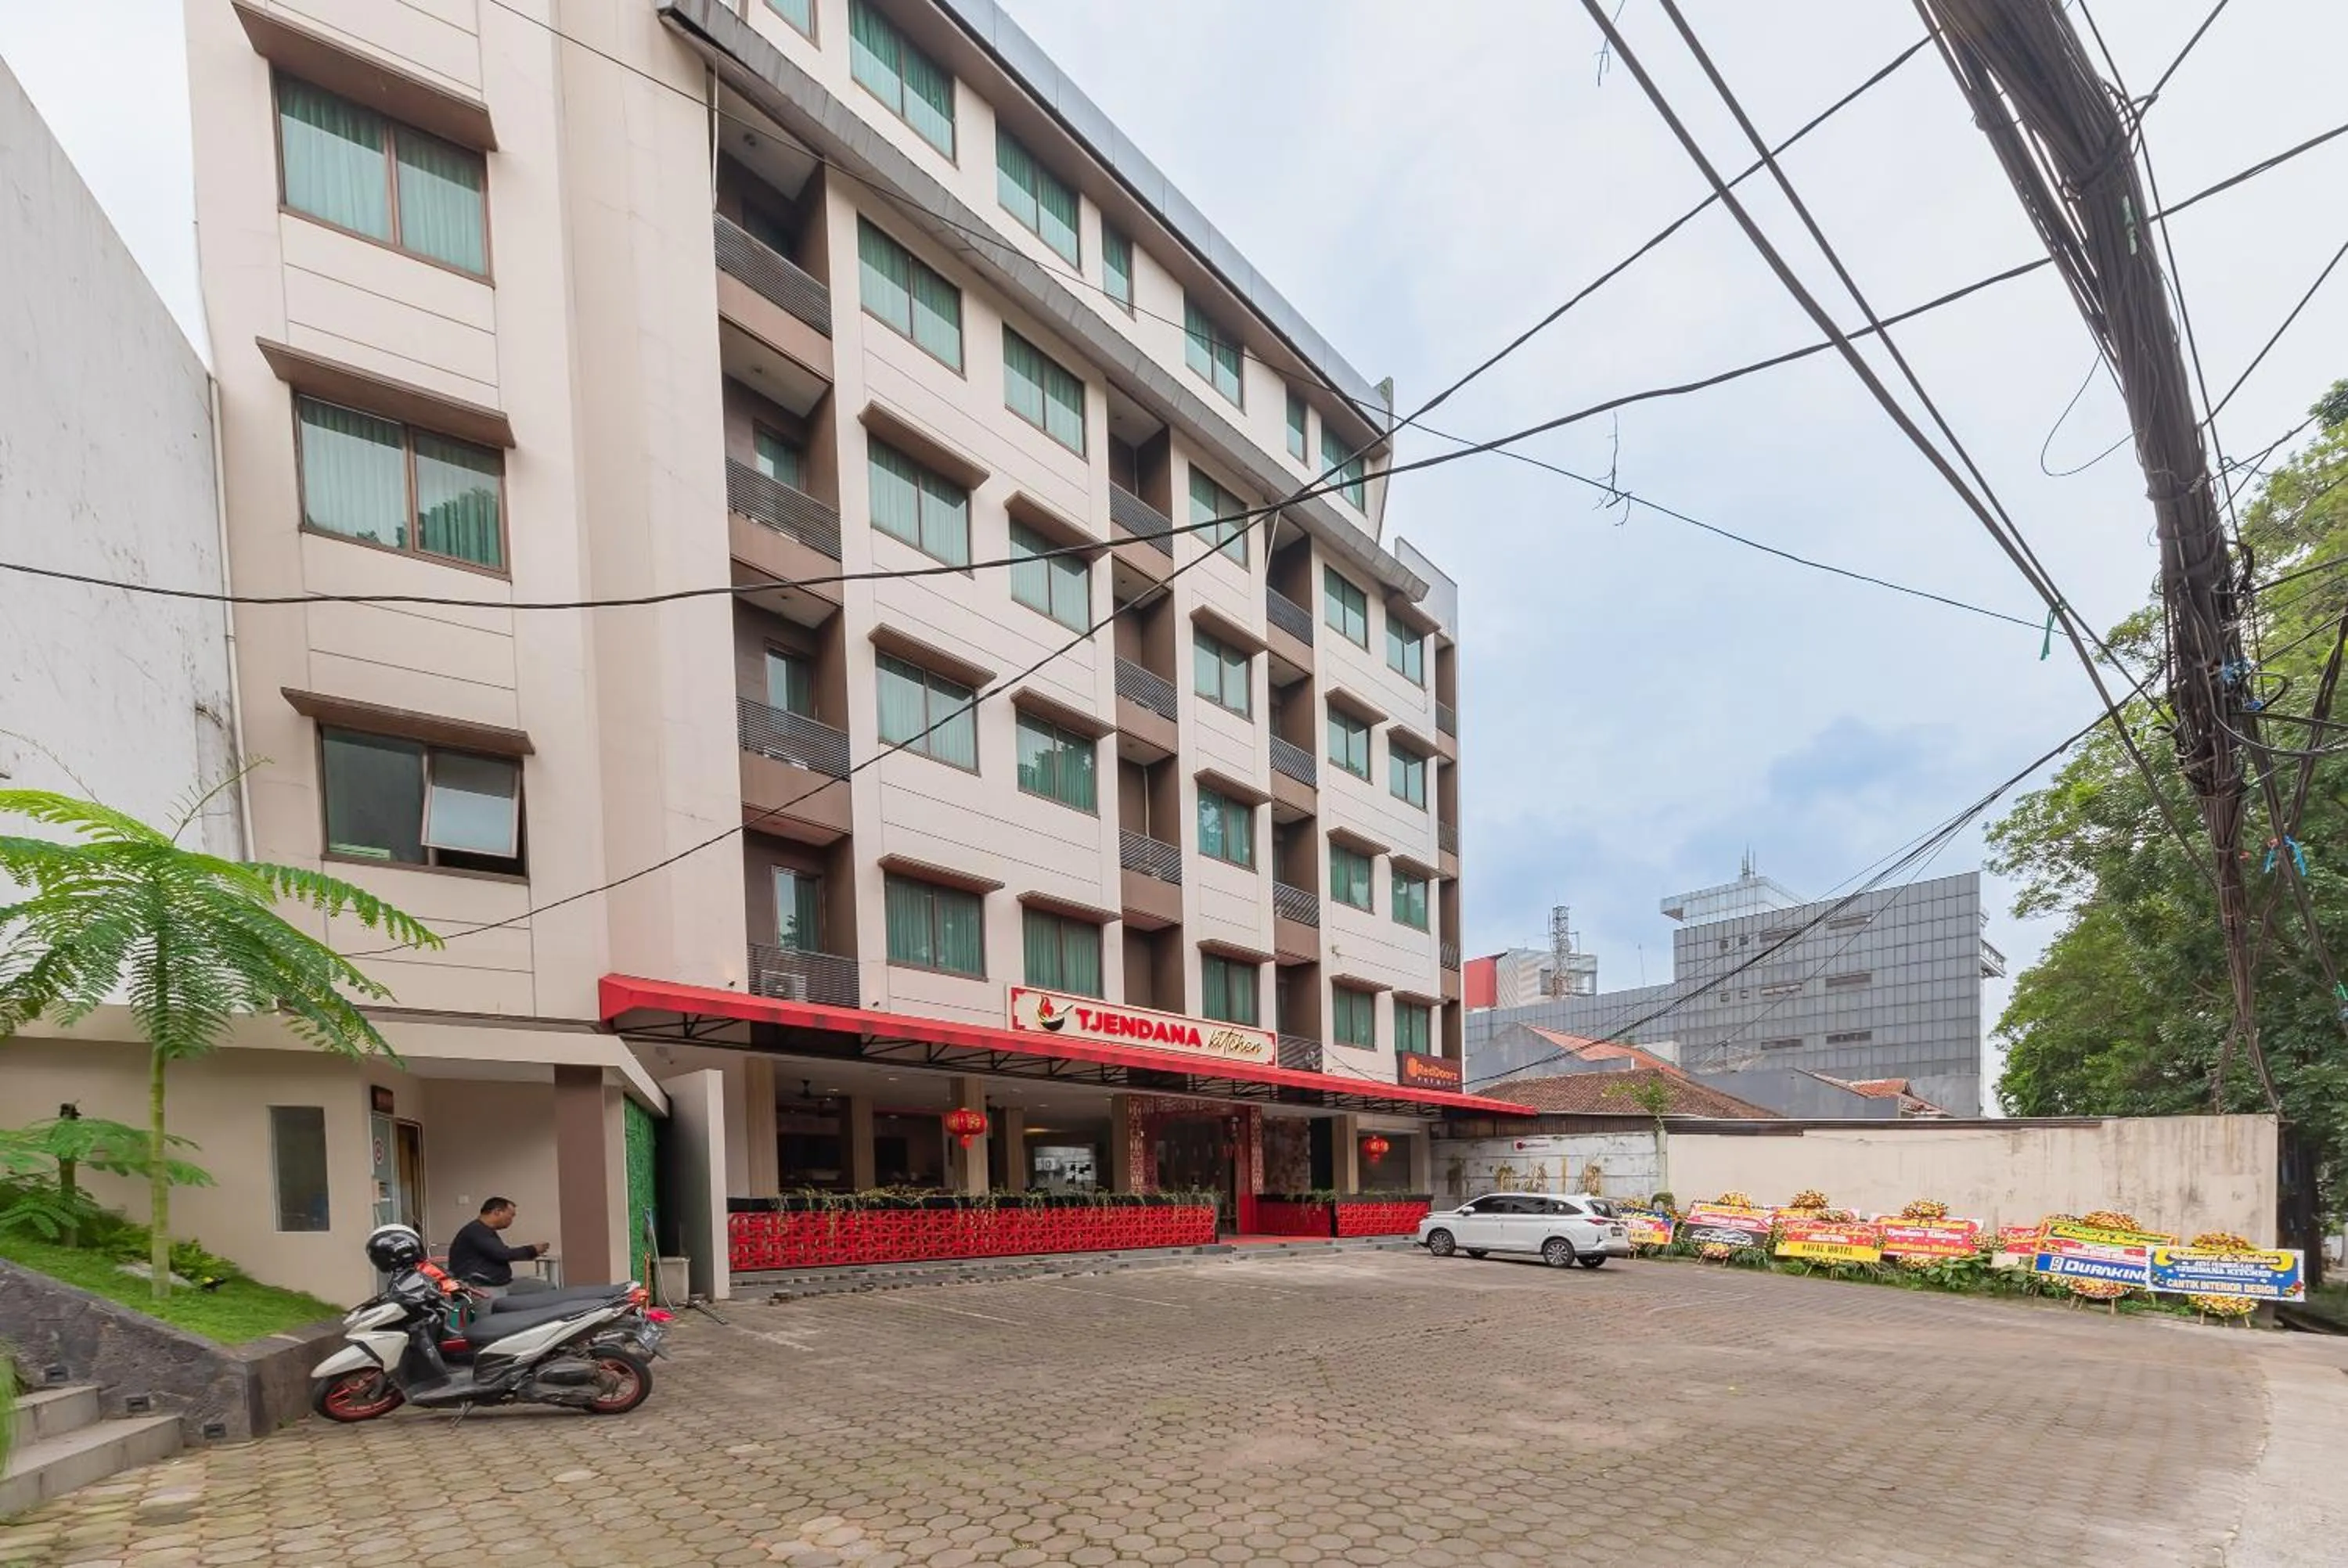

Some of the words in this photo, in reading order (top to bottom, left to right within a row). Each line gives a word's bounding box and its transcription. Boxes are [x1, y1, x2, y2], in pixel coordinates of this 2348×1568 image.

[1075, 1007, 1202, 1048] TJENDANA
[1208, 1027, 1263, 1056] kitchen
[2227, 1268, 2274, 1277] KITCHEN
[2166, 1278, 2199, 1289] CANTIK
[2200, 1281, 2242, 1293] INTERIOR
[2244, 1283, 2278, 1295] DESIGN
